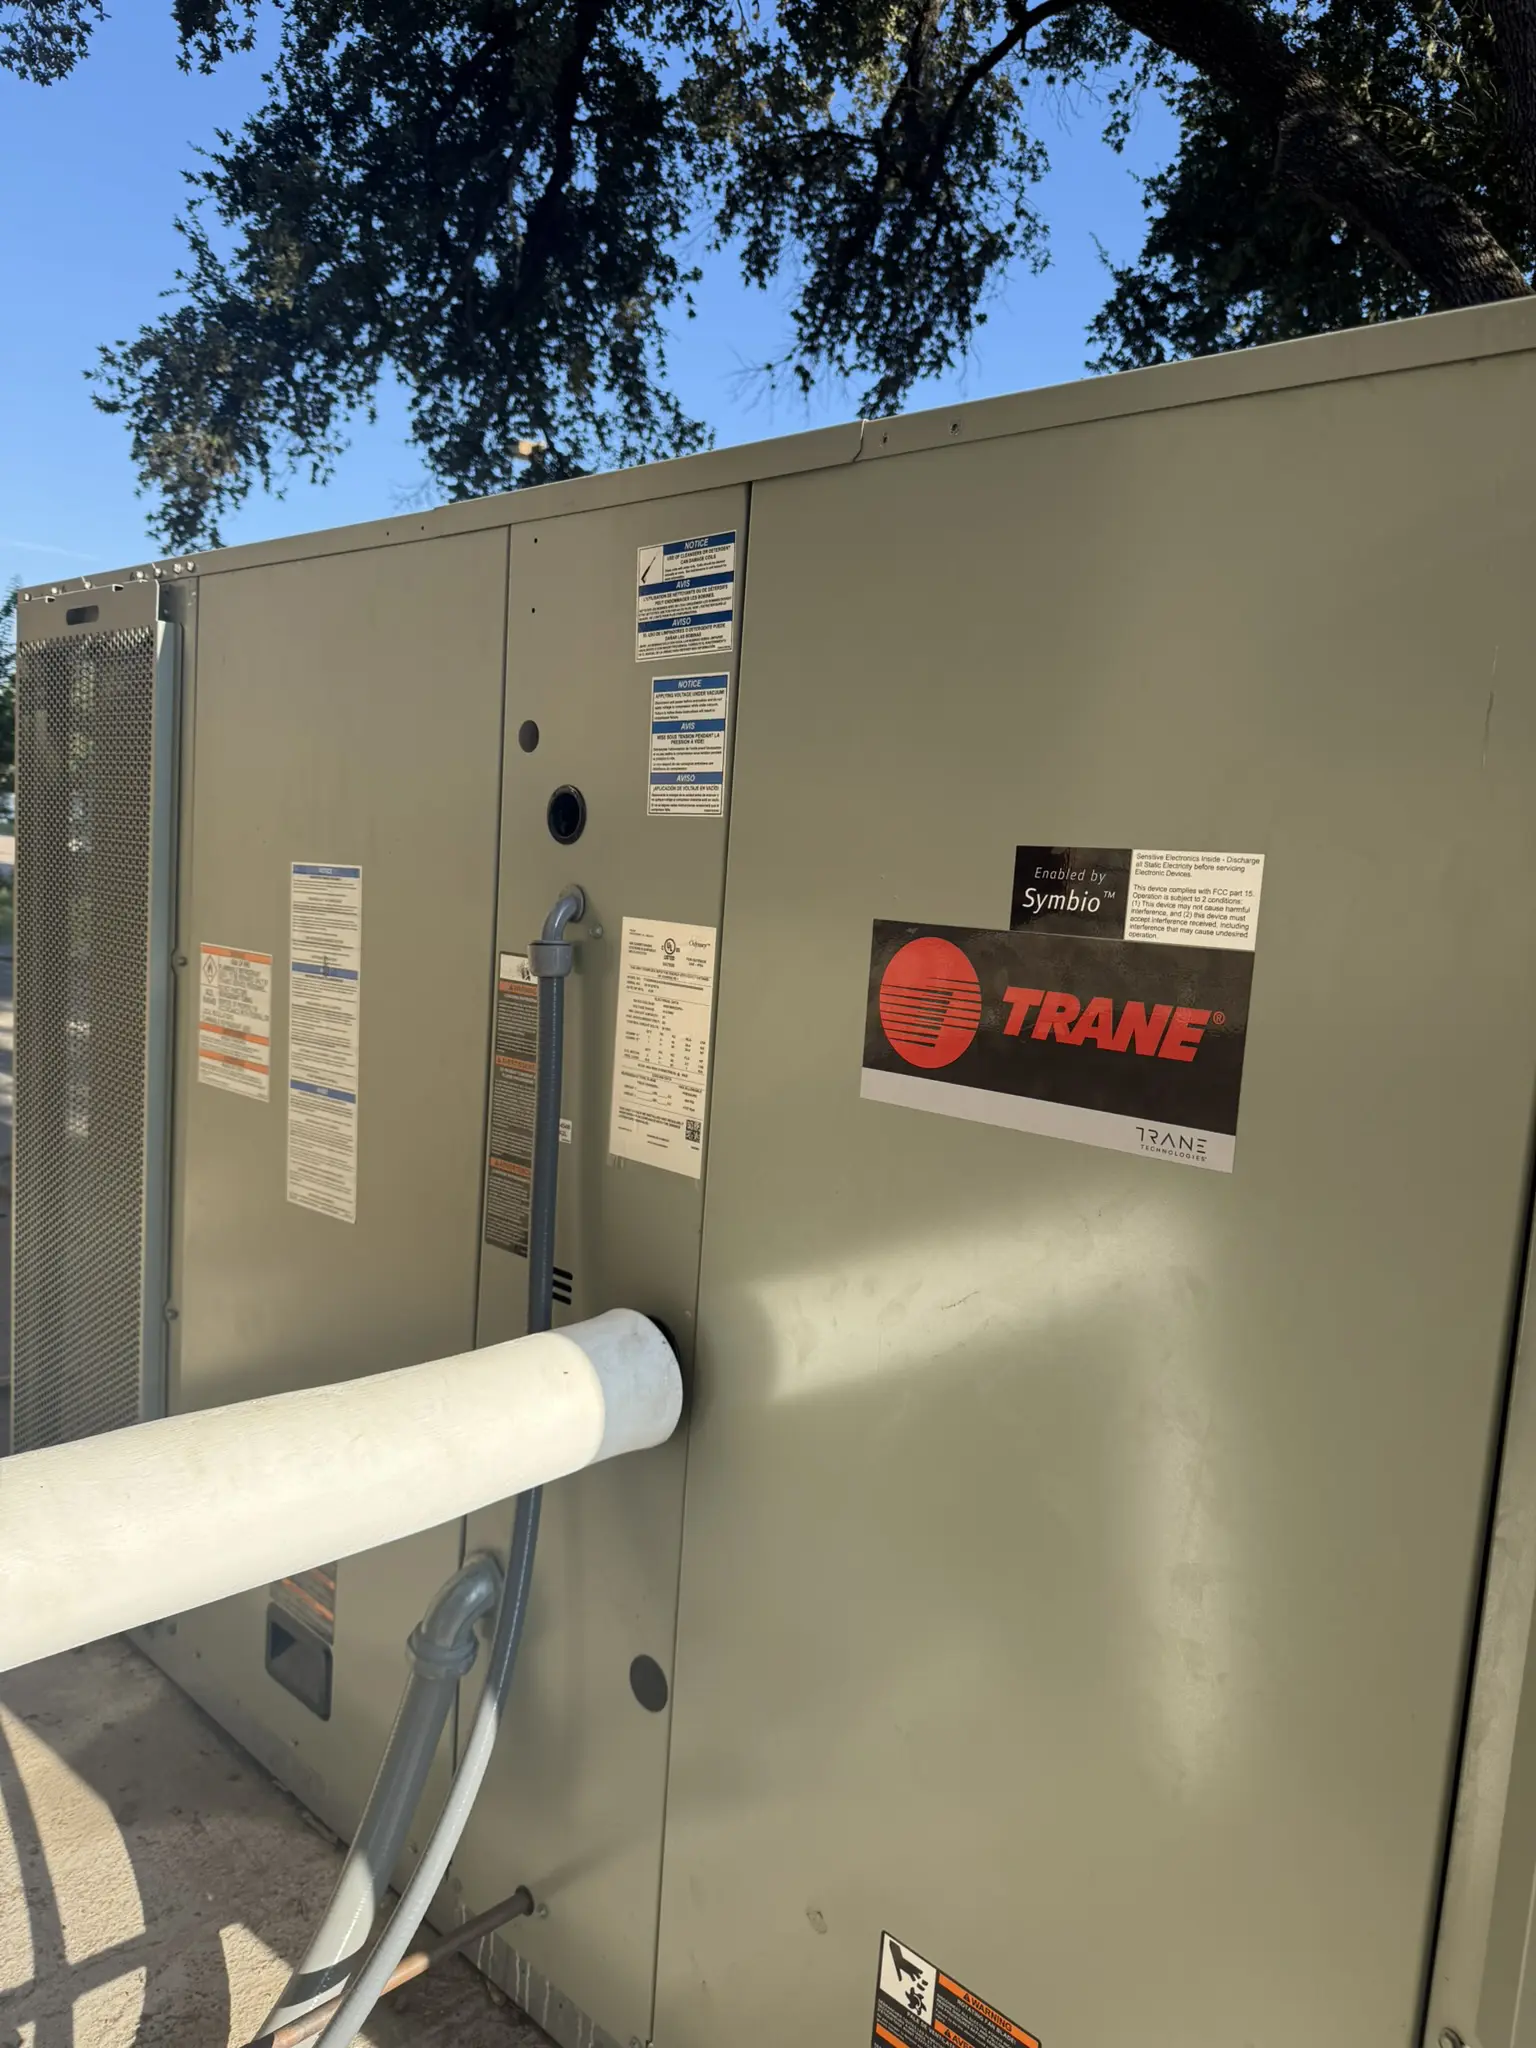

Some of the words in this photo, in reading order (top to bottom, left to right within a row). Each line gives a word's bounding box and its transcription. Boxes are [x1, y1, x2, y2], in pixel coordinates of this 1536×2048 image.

[685, 538, 709, 550] NOTICE
[676, 580, 691, 590] AVIS
[672, 617, 692, 627] AVISO
[678, 679, 702, 689] NOTICE
[681, 722, 695, 730] AVIS
[676, 774, 696, 782] AVISO
[1136, 852, 1164, 861] Sensitive
[1166, 853, 1200, 863] Electronics
[1226, 856, 1260, 866] Discharge
[1144, 861, 1162, 869] Static
[1163, 861, 1193, 871] Electricity
[1194, 863, 1214, 871] before
[1034, 867, 1086, 881] Enabled
[1091, 869, 1107, 885] by
[1134, 868, 1165, 876] Electronic
[1166, 870, 1192, 878] Devices.
[1132, 892, 1163, 900] Operation
[1170, 895, 1193, 903] subject
[1169, 887, 1197, 895] complies
[1212, 888, 1228, 896] FCC
[1230, 890, 1243, 898] part
[1142, 900, 1155, 908] This
[1177, 903, 1191, 911] may
[1183, 911, 1193, 919] (2)
[1130, 916, 1151, 924] accept
[1152, 917, 1188, 926] interference
[1129, 924, 1165, 932] interference
[1180, 927, 1193, 936] may
[1216, 930, 1249, 938] undesired
[1136, 1126, 1208, 1155] TRANE
[971, 1998, 1013, 2032] WARNING
